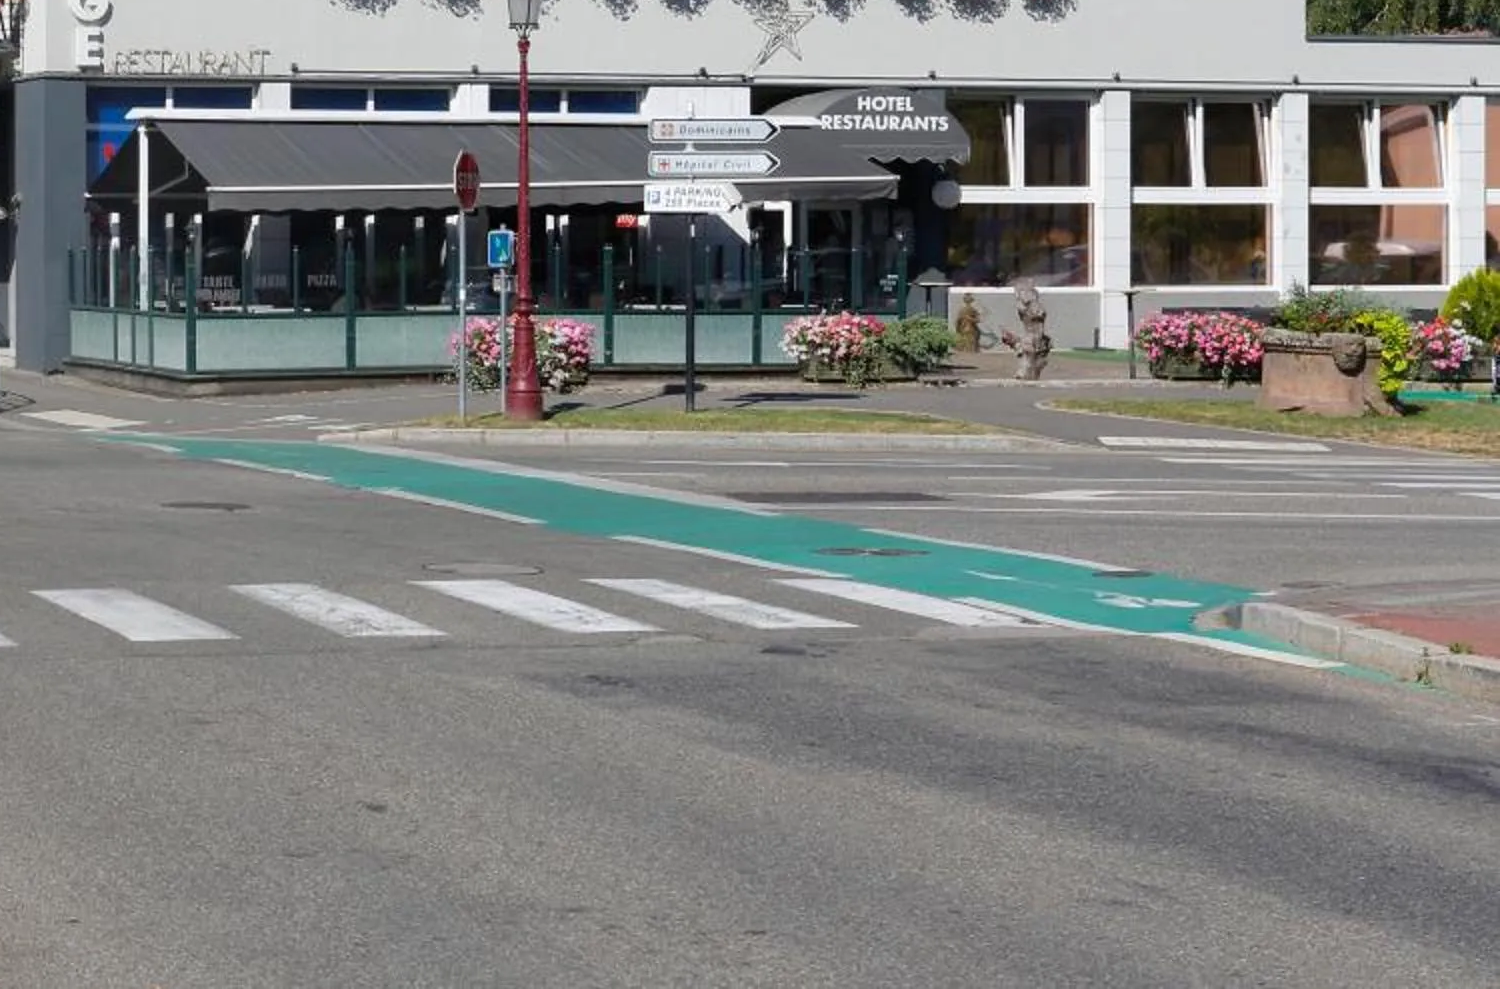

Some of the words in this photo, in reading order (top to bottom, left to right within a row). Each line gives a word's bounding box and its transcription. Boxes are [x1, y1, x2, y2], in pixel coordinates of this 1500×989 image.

[114, 50, 272, 75] RESTAURANT
[857, 96, 914, 111] HOTEL
[679, 123, 751, 136] Dominicains
[820, 114, 949, 131] RESTAURANTS
[723, 160, 751, 170] Civil
